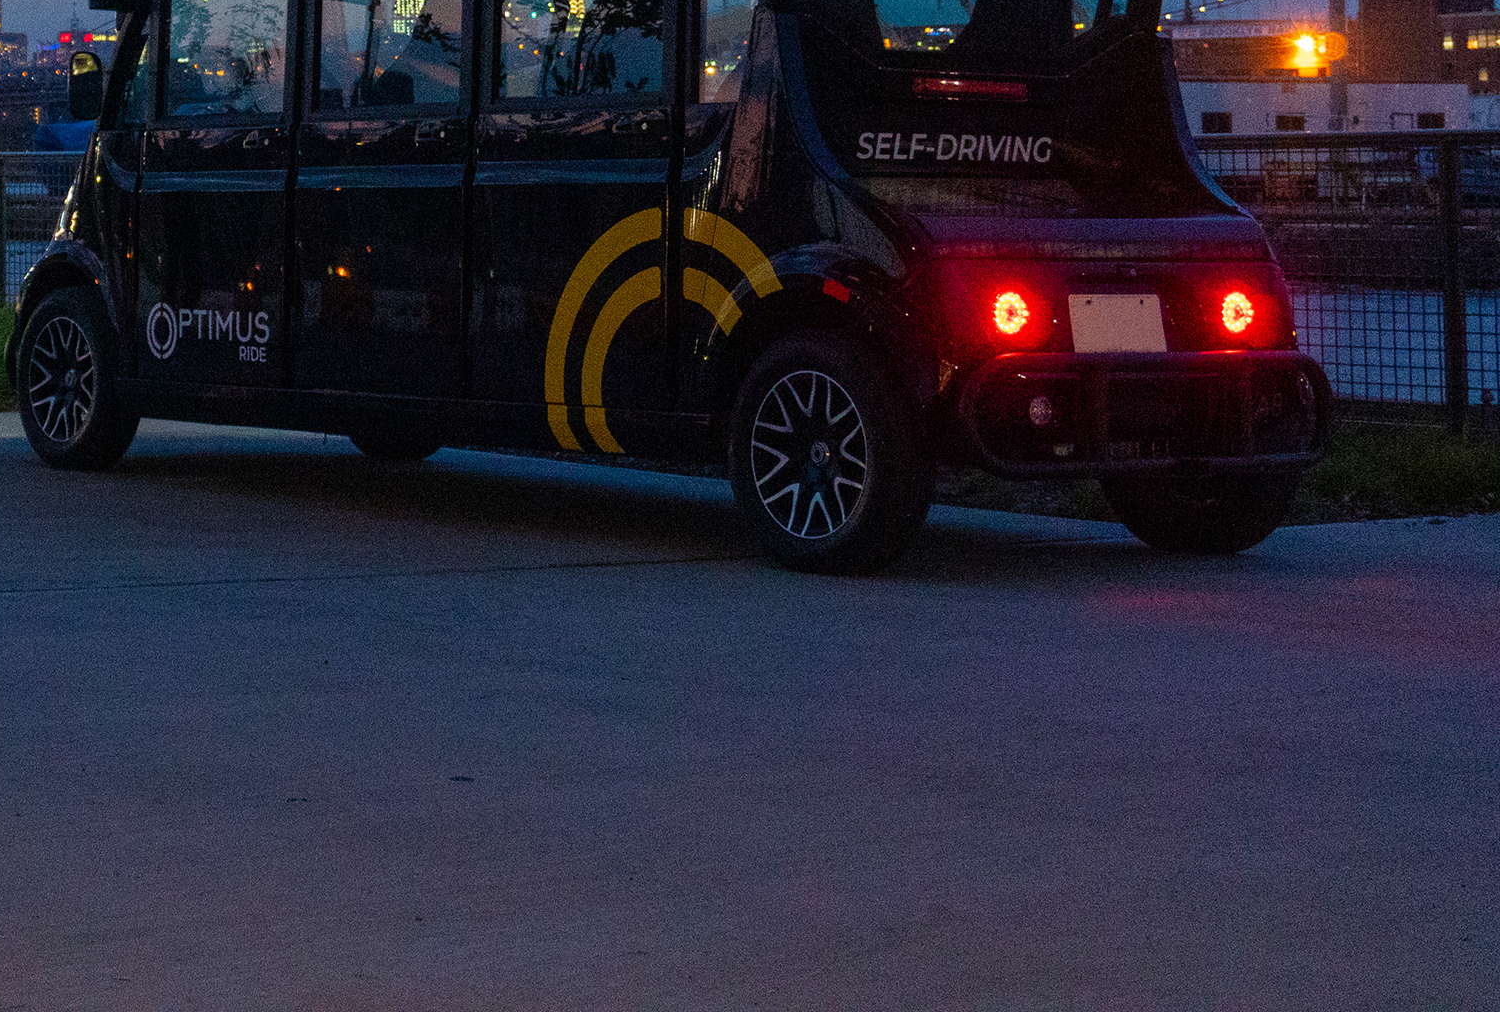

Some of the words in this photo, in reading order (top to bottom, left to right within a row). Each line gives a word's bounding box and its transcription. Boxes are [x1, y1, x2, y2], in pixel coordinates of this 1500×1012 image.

[856, 132, 1052, 163] SELF-DRIVING
[146, 302, 270, 360] OPTIMUS
[239, 346, 267, 362] RIDE
